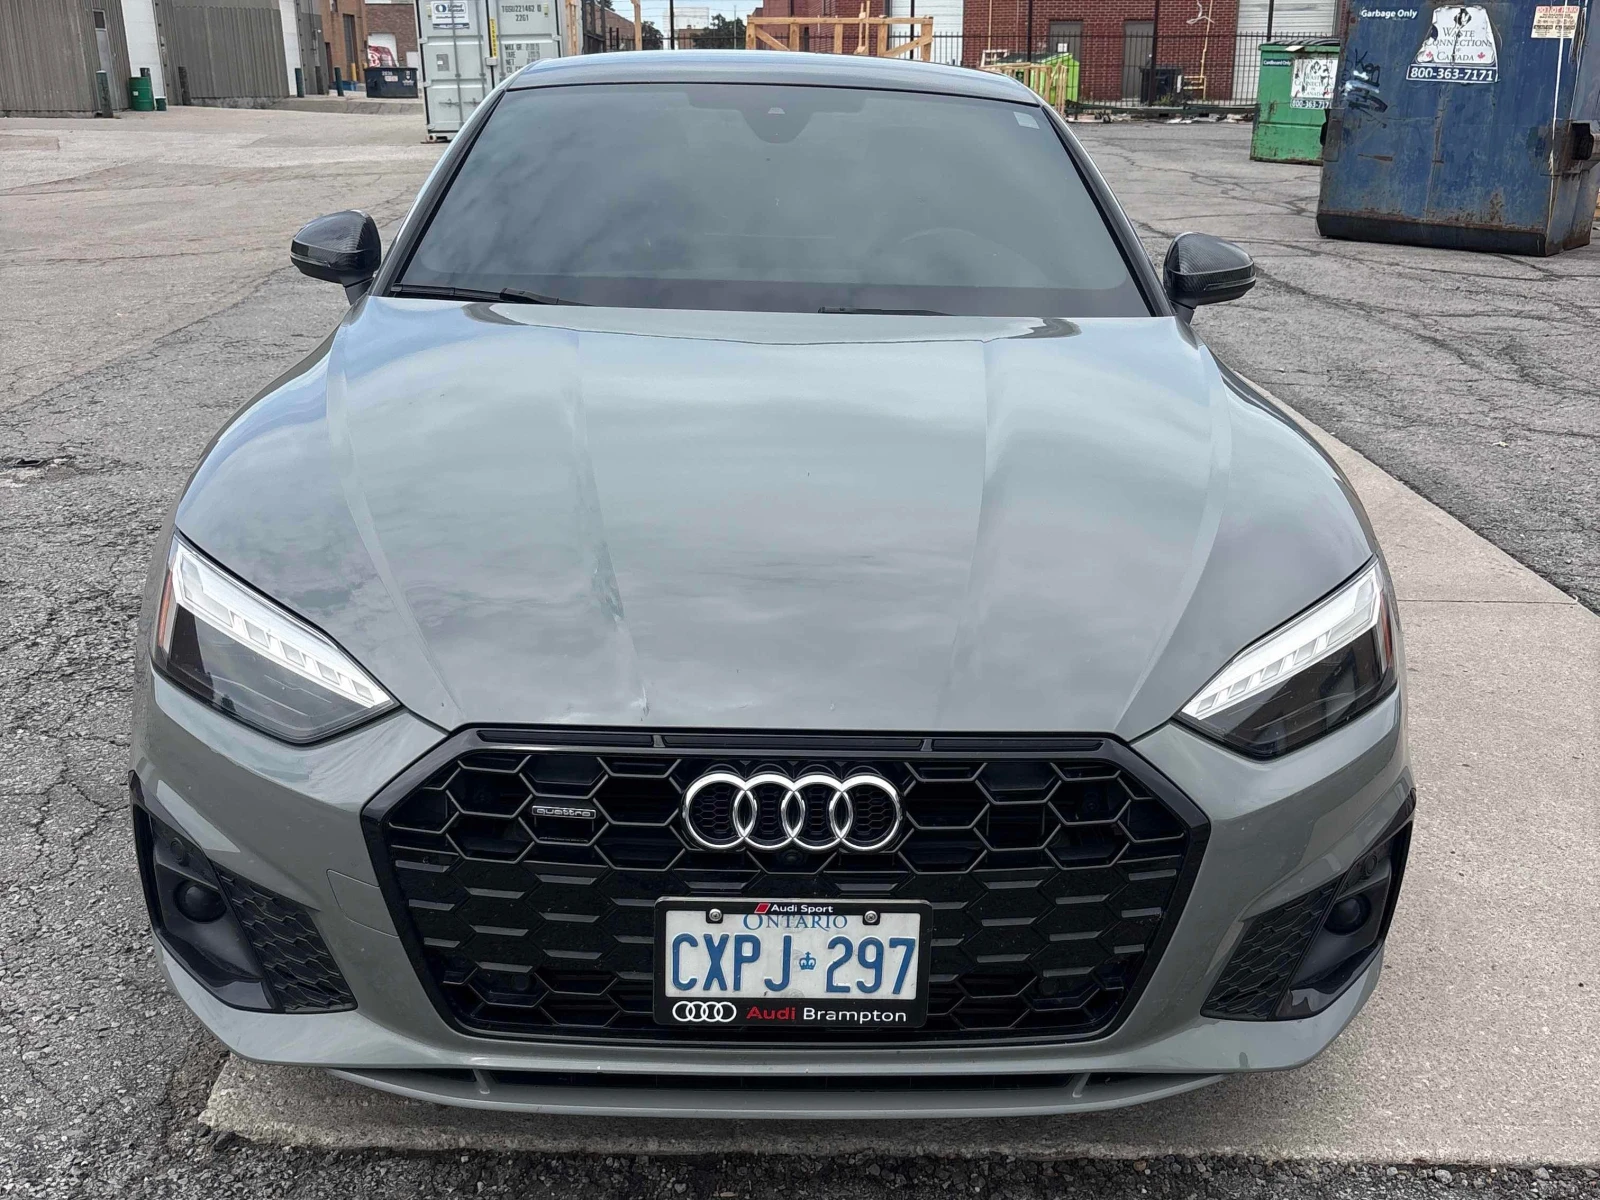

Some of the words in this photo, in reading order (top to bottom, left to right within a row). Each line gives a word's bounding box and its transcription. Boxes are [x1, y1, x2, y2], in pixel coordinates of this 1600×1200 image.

[1361, 9, 1396, 19] Garbage
[1397, 9, 1418, 18] Only
[1410, 67, 1493, 81] 800-363-7171
[536, 808, 591, 816] quattro
[800, 905, 834, 914] Sport
[743, 914, 848, 932] ONTARIO
[672, 933, 793, 992] CXPJ
[825, 935, 916, 995] 297
[746, 1006, 796, 1021] Audi
[803, 1007, 907, 1024] Brampton
